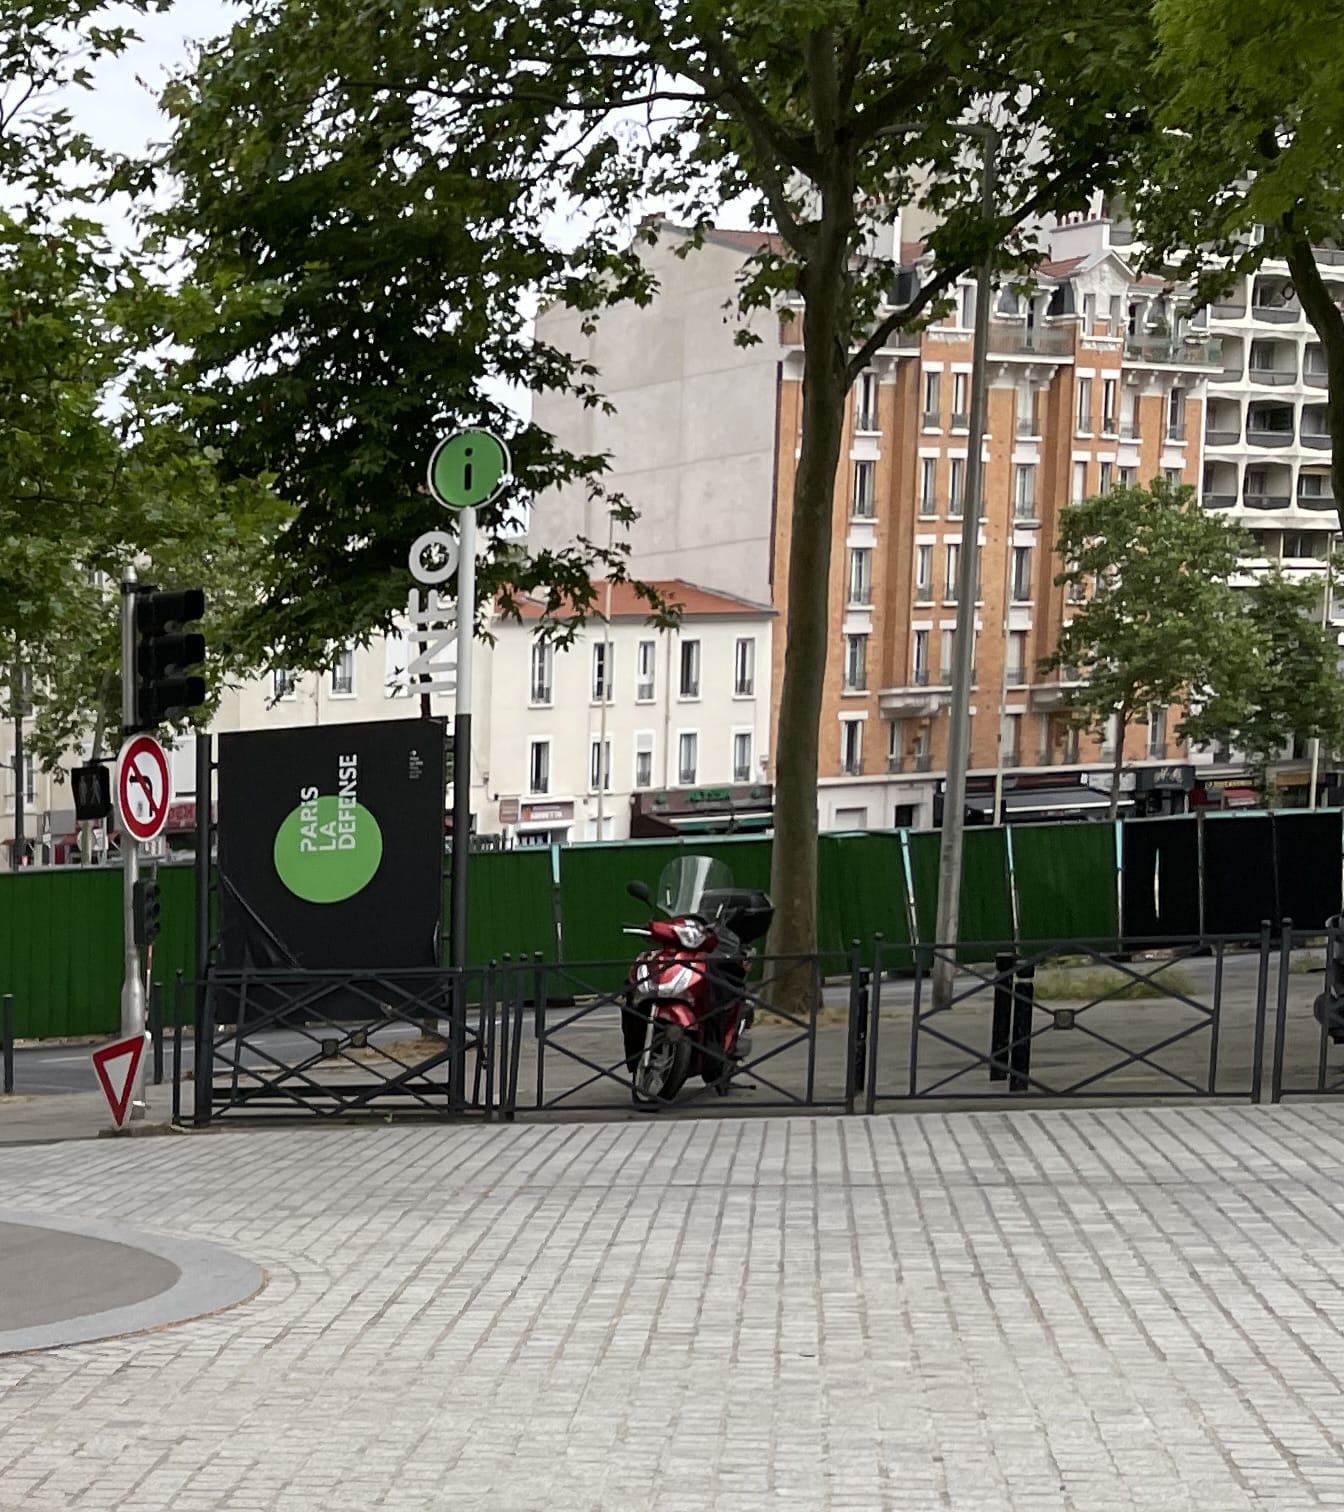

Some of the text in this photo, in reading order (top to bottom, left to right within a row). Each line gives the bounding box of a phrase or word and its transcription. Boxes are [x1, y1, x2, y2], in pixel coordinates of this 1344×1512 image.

[408, 530, 459, 698] INFO
[300, 786, 319, 853] PARIS
[319, 820, 337, 851] LA
[338, 754, 358, 850] DEFENSE
